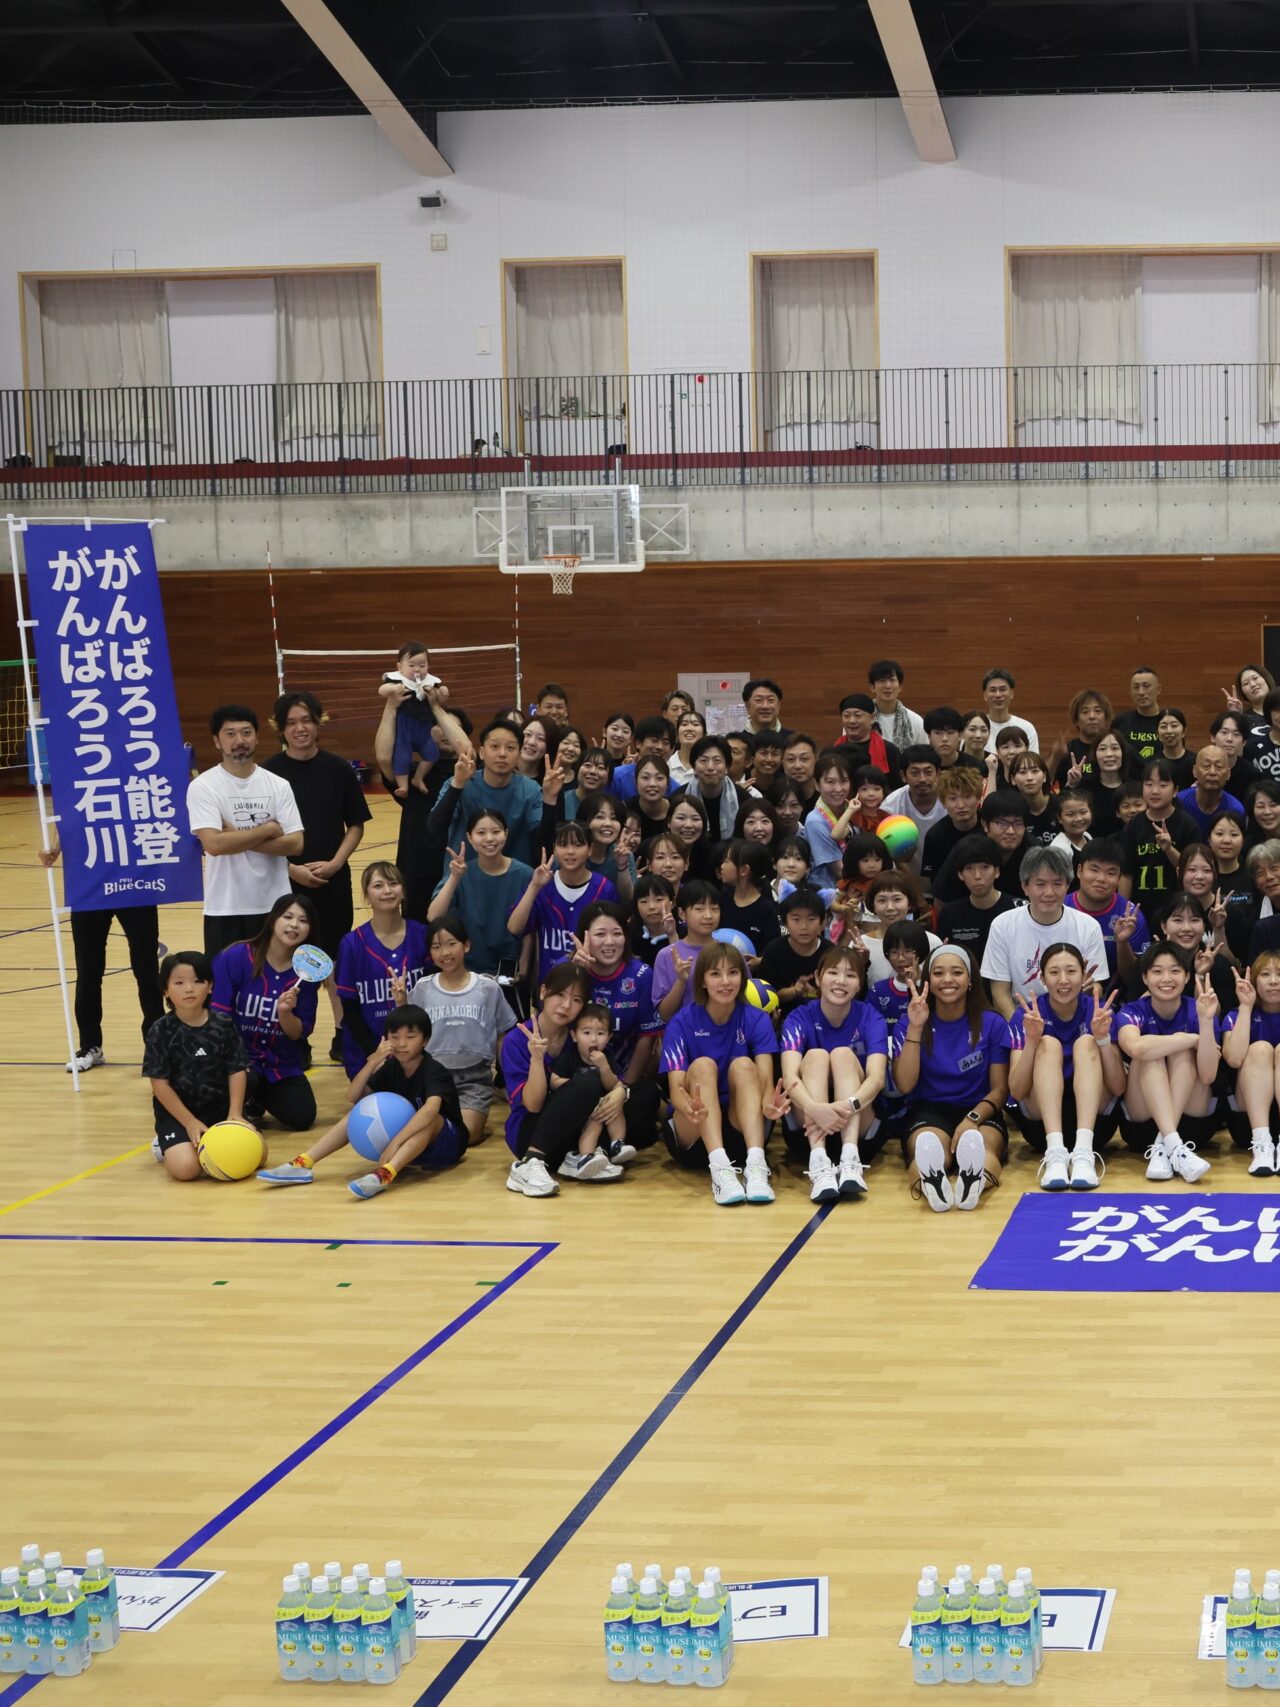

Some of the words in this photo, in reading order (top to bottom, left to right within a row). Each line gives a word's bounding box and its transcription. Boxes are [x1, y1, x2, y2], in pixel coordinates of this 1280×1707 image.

[48, 546, 130, 869] がんばろう石川
[95, 545, 180, 866] がんばろう能登
[1137, 865, 1168, 890] 11
[414, 1597, 484, 1610] ディス
[733, 1604, 788, 1622] Eプ
